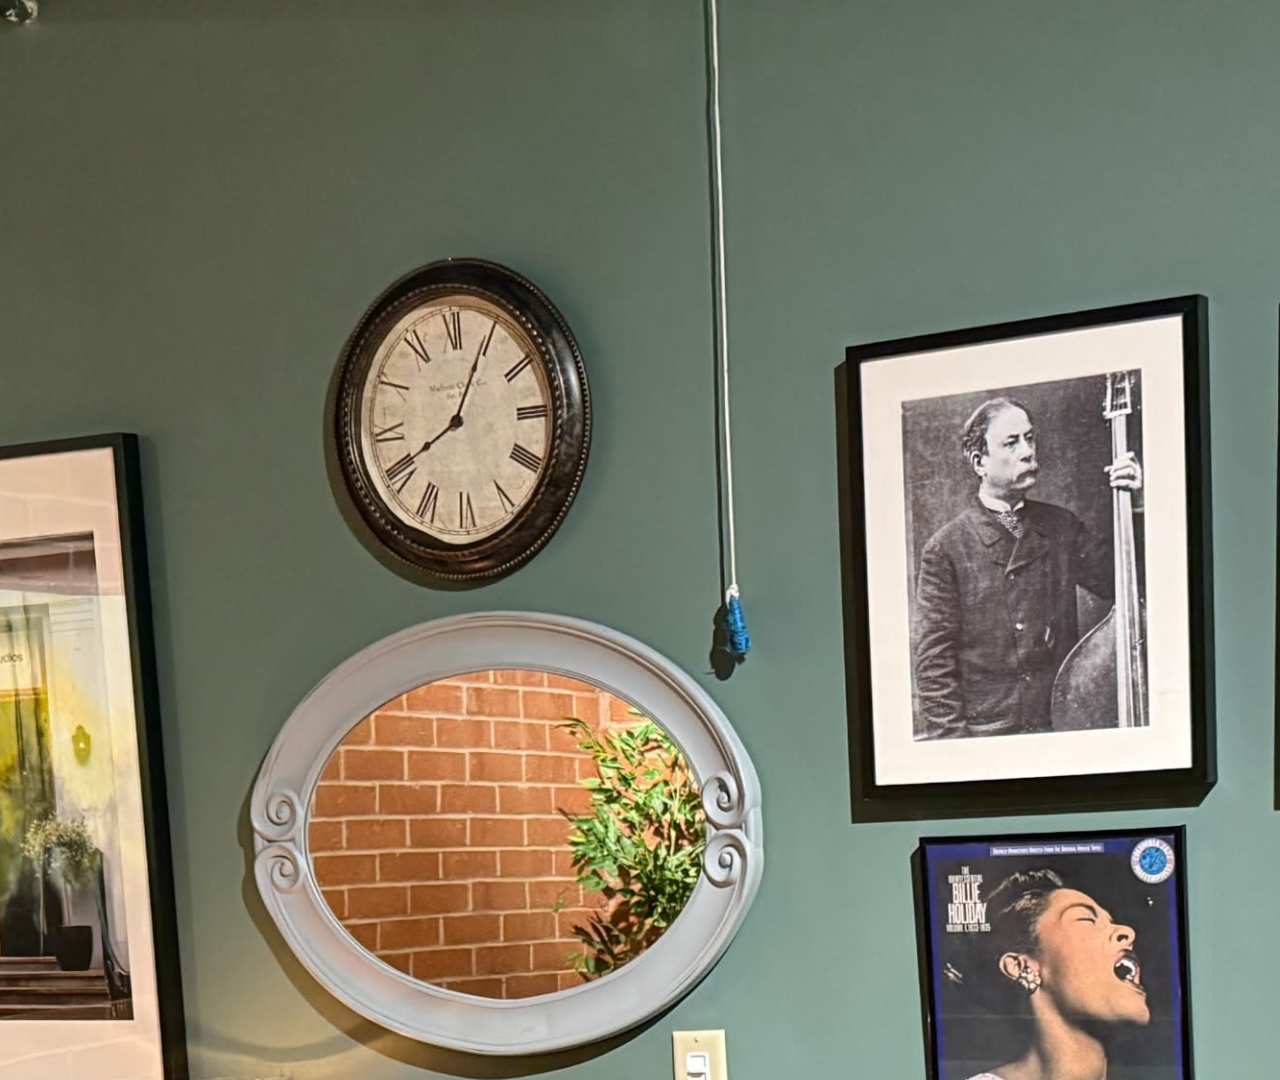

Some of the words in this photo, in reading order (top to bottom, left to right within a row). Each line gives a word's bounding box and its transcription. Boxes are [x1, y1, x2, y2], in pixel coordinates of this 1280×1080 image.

[517, 404, 548, 420] III
[952, 882, 981, 903] BILLIE
[948, 903, 987, 924] HOLIDAY
